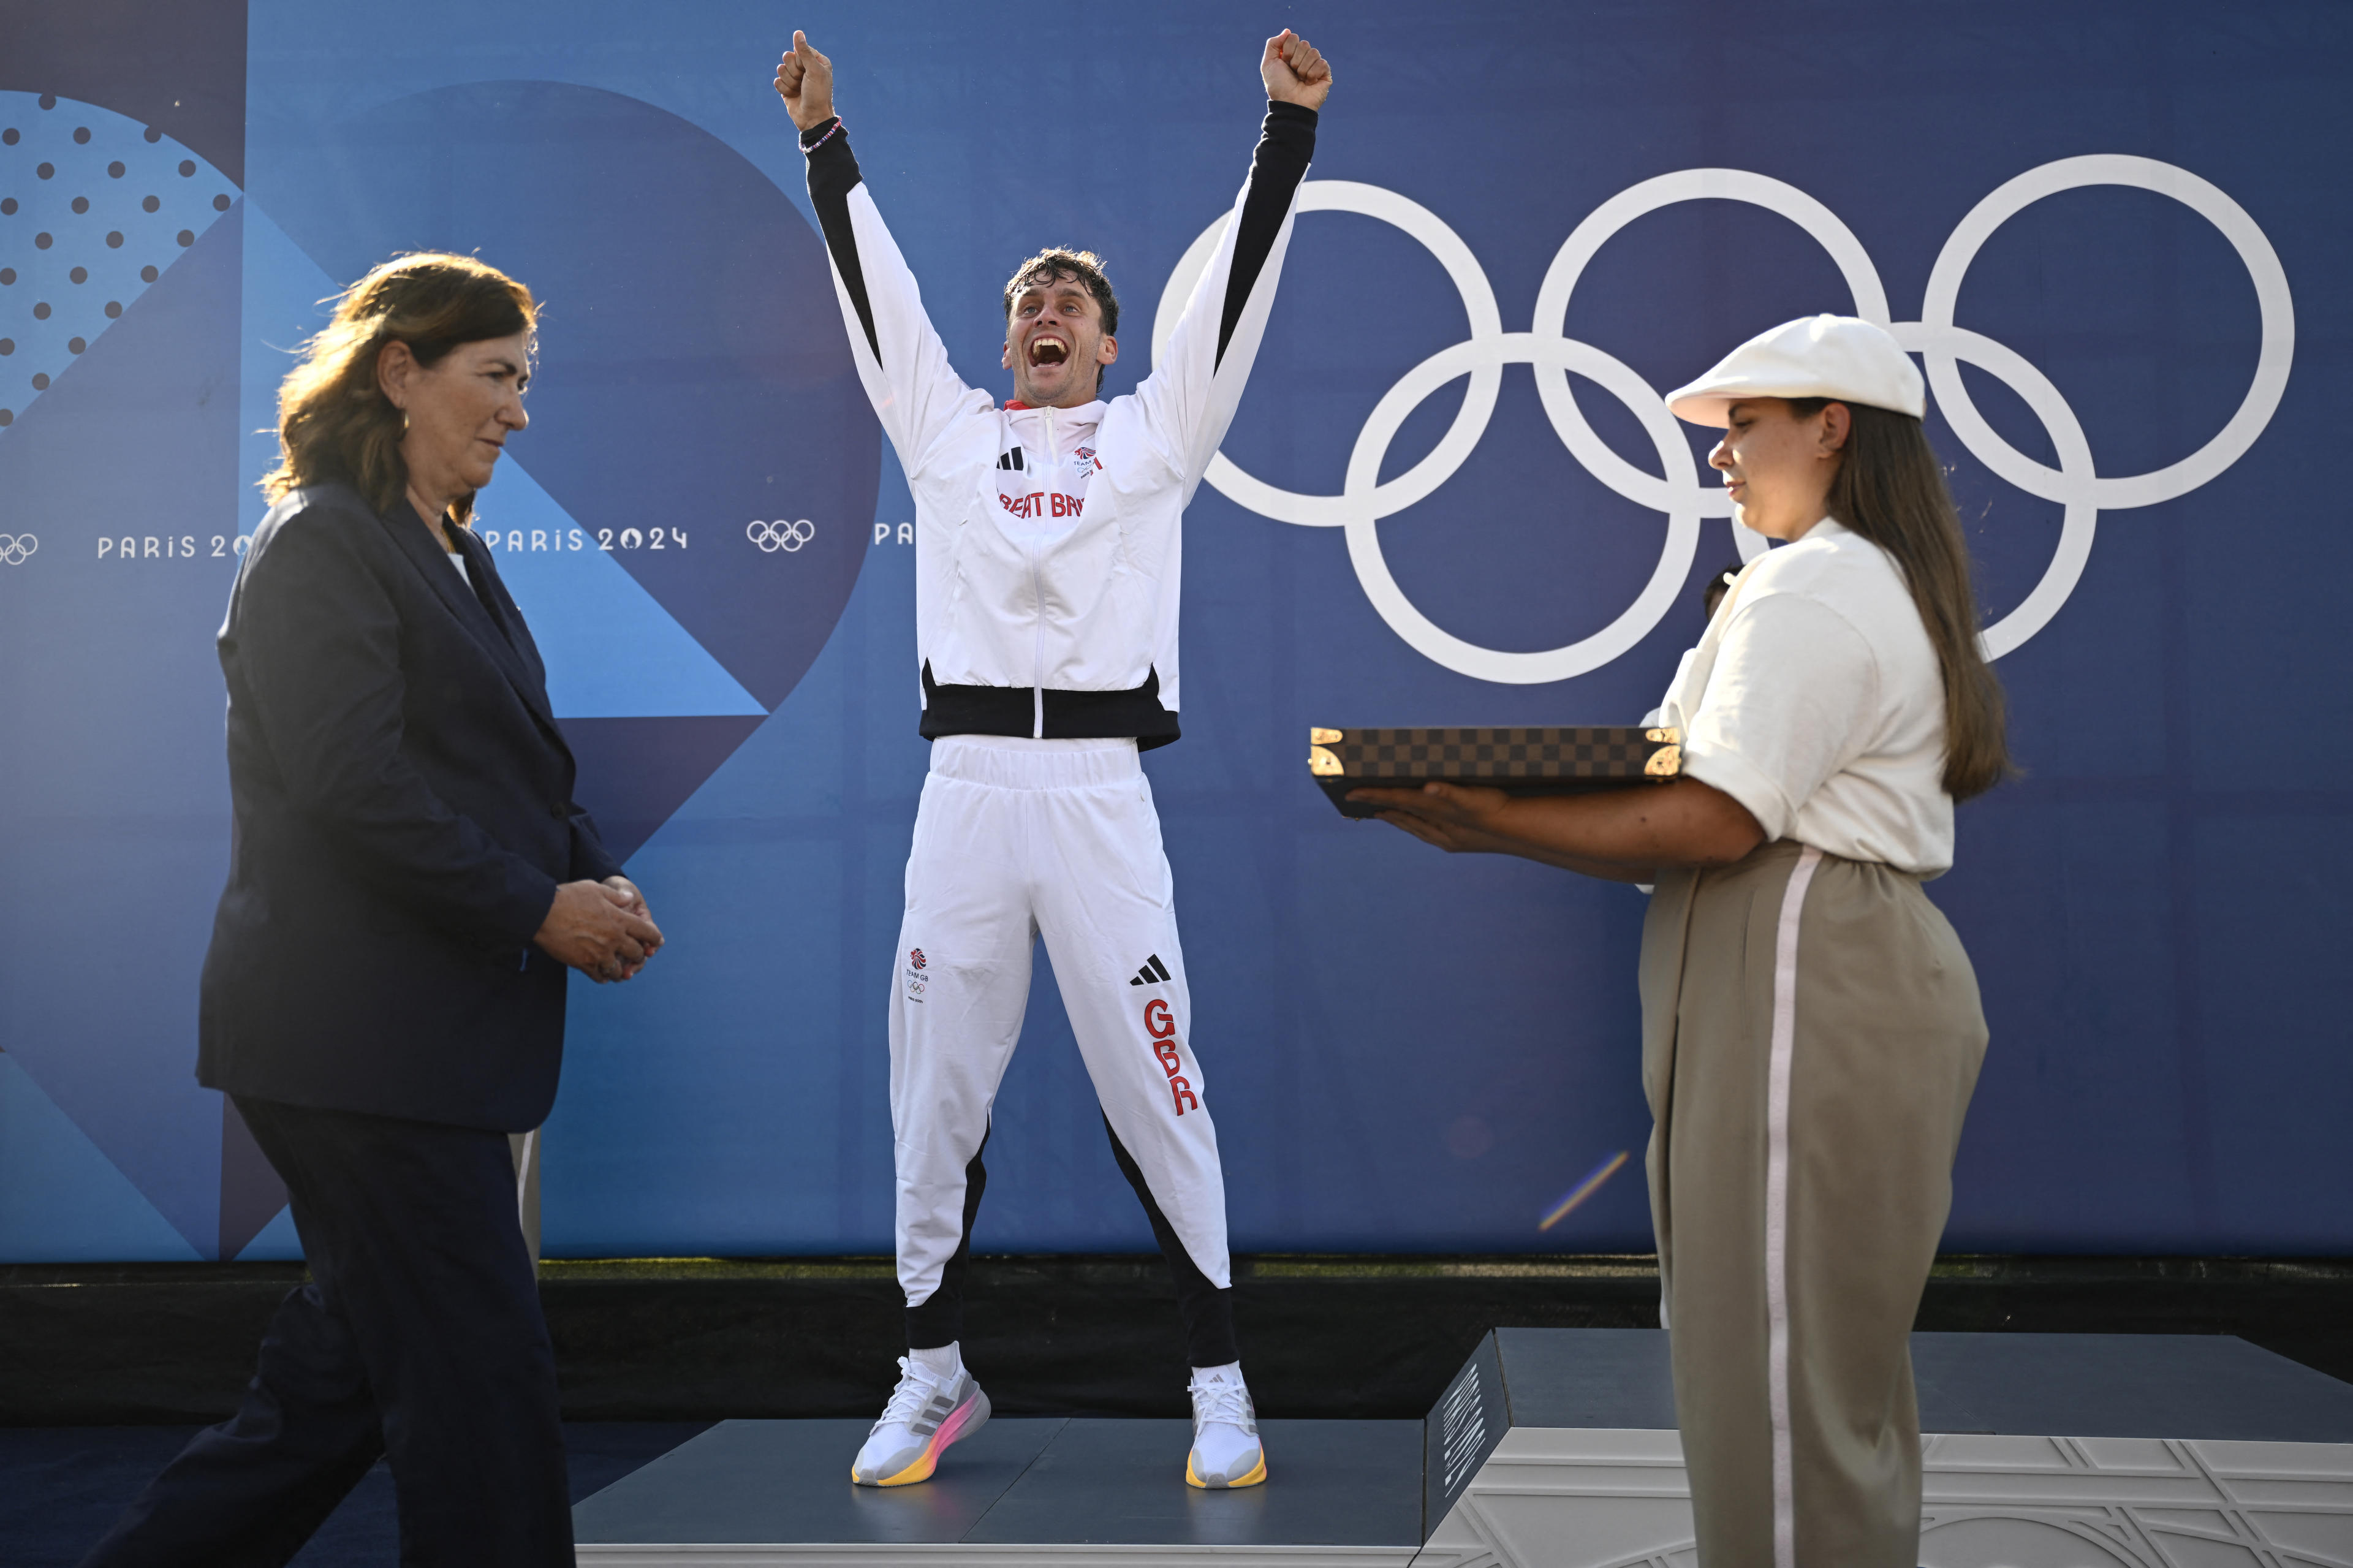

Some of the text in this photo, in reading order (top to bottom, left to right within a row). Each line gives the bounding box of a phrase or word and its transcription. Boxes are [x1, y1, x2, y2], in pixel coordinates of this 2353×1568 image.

[999, 492, 1085, 519] REAT BRI
[598, 527, 687, 550] 2024
[906, 969, 919, 979] TEAM
[1144, 999, 1198, 1116] GBR
